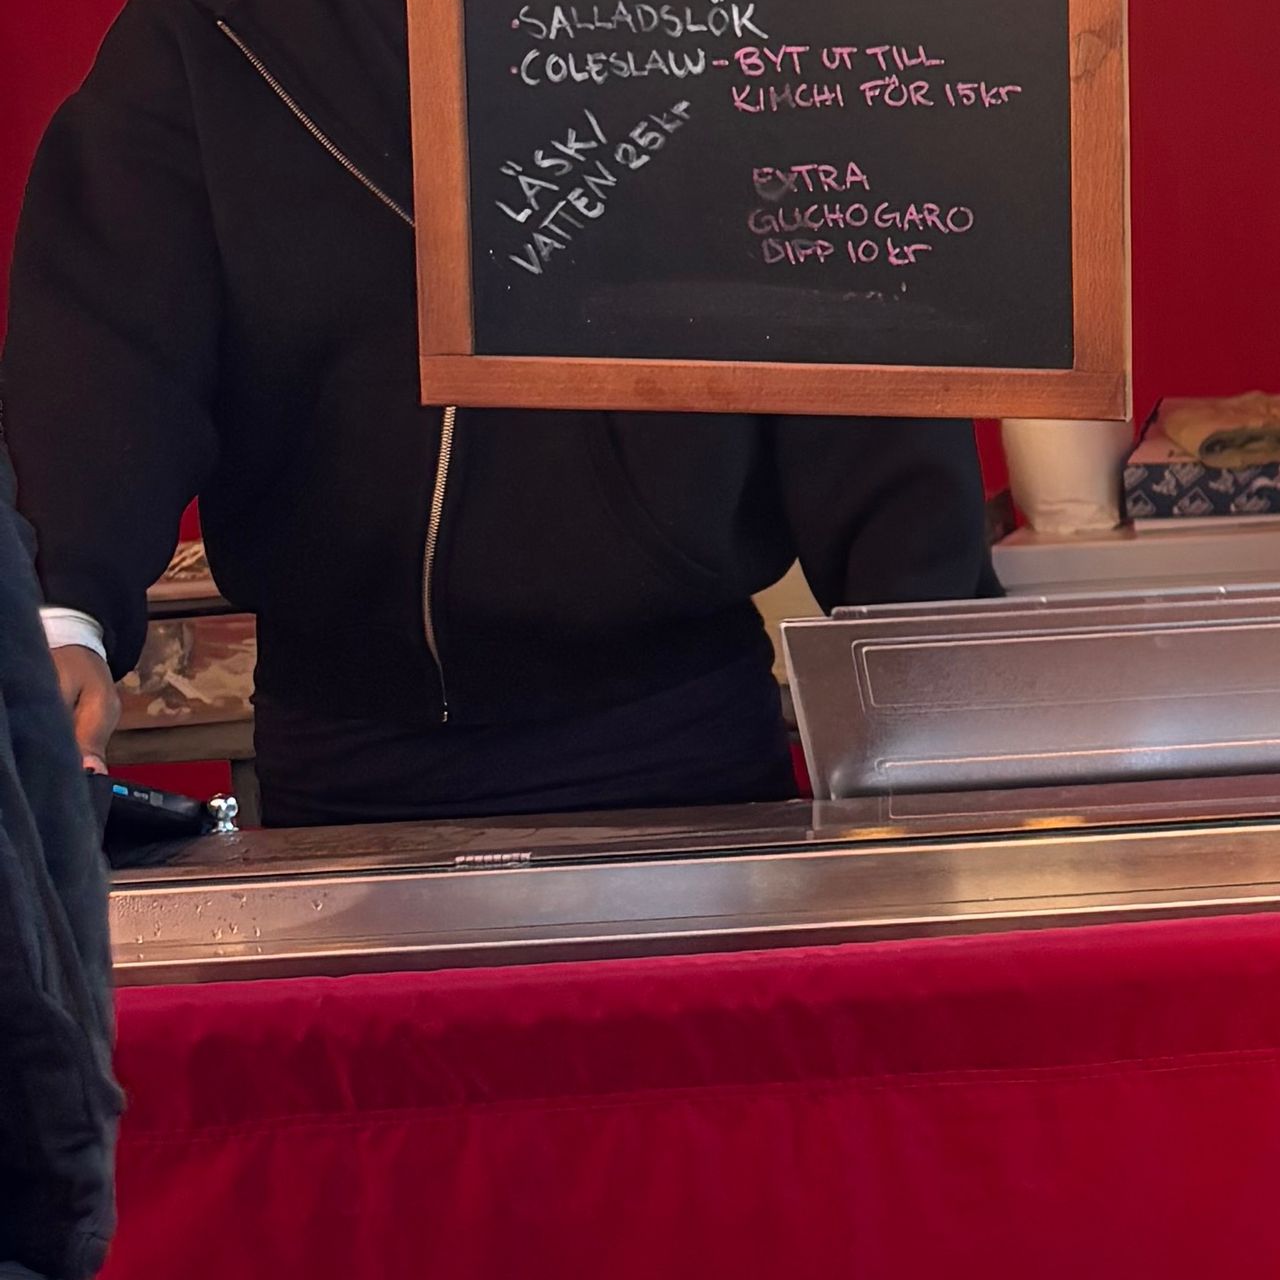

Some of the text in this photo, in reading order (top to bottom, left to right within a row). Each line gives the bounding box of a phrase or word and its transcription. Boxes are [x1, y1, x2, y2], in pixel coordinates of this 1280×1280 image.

[520, 48, 706, 86] COLESLAW
[734, 45, 810, 76] BYT
[822, 46, 857, 70] UT
[865, 44, 945, 71] TILL
[731, 82, 844, 113] KIMCHI
[859, 74, 934, 108] FÖR
[752, 161, 870, 193] EXTRA
[508, 160, 617, 275] VATTEN
